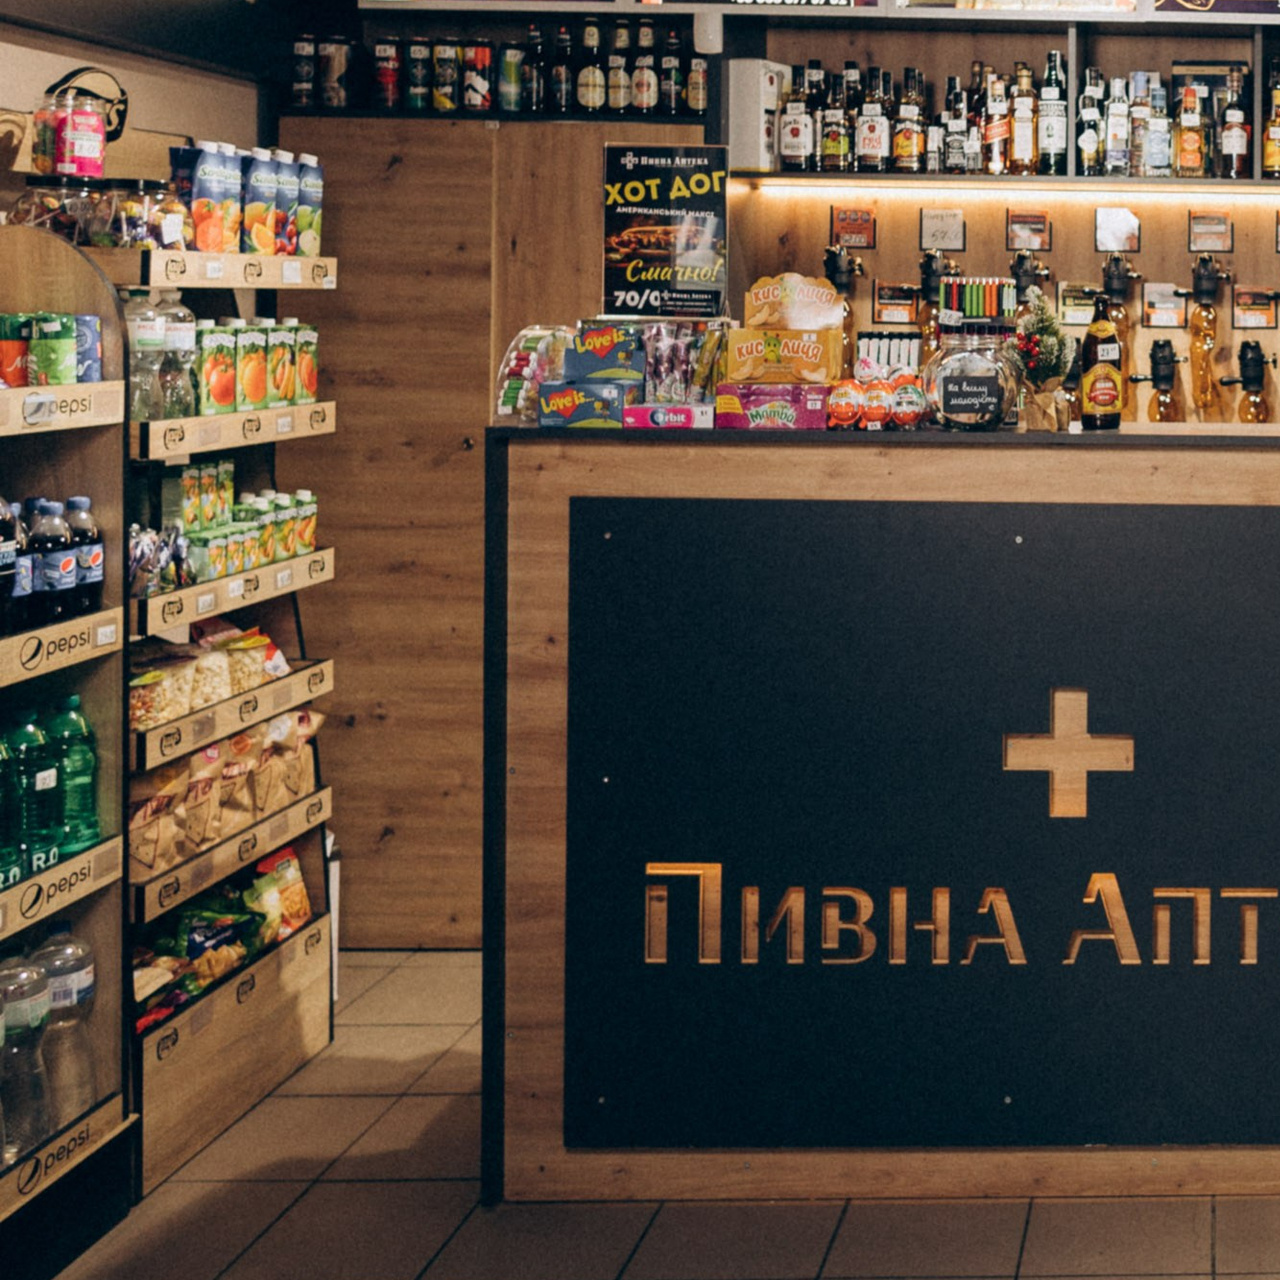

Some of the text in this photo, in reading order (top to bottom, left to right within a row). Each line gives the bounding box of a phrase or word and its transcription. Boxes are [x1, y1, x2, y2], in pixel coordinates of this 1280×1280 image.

[604, 171, 727, 205] ХОТ ДОГ
[616, 206, 687, 217] АМЕРИКАНСЬКИЙ
[626, 259, 724, 283] Смачно!
[48, 394, 92, 418] pepsi
[46, 630, 91, 662] pepsi
[45, 863, 91, 900] pepsi
[43, 1124, 90, 1178] pepsi
